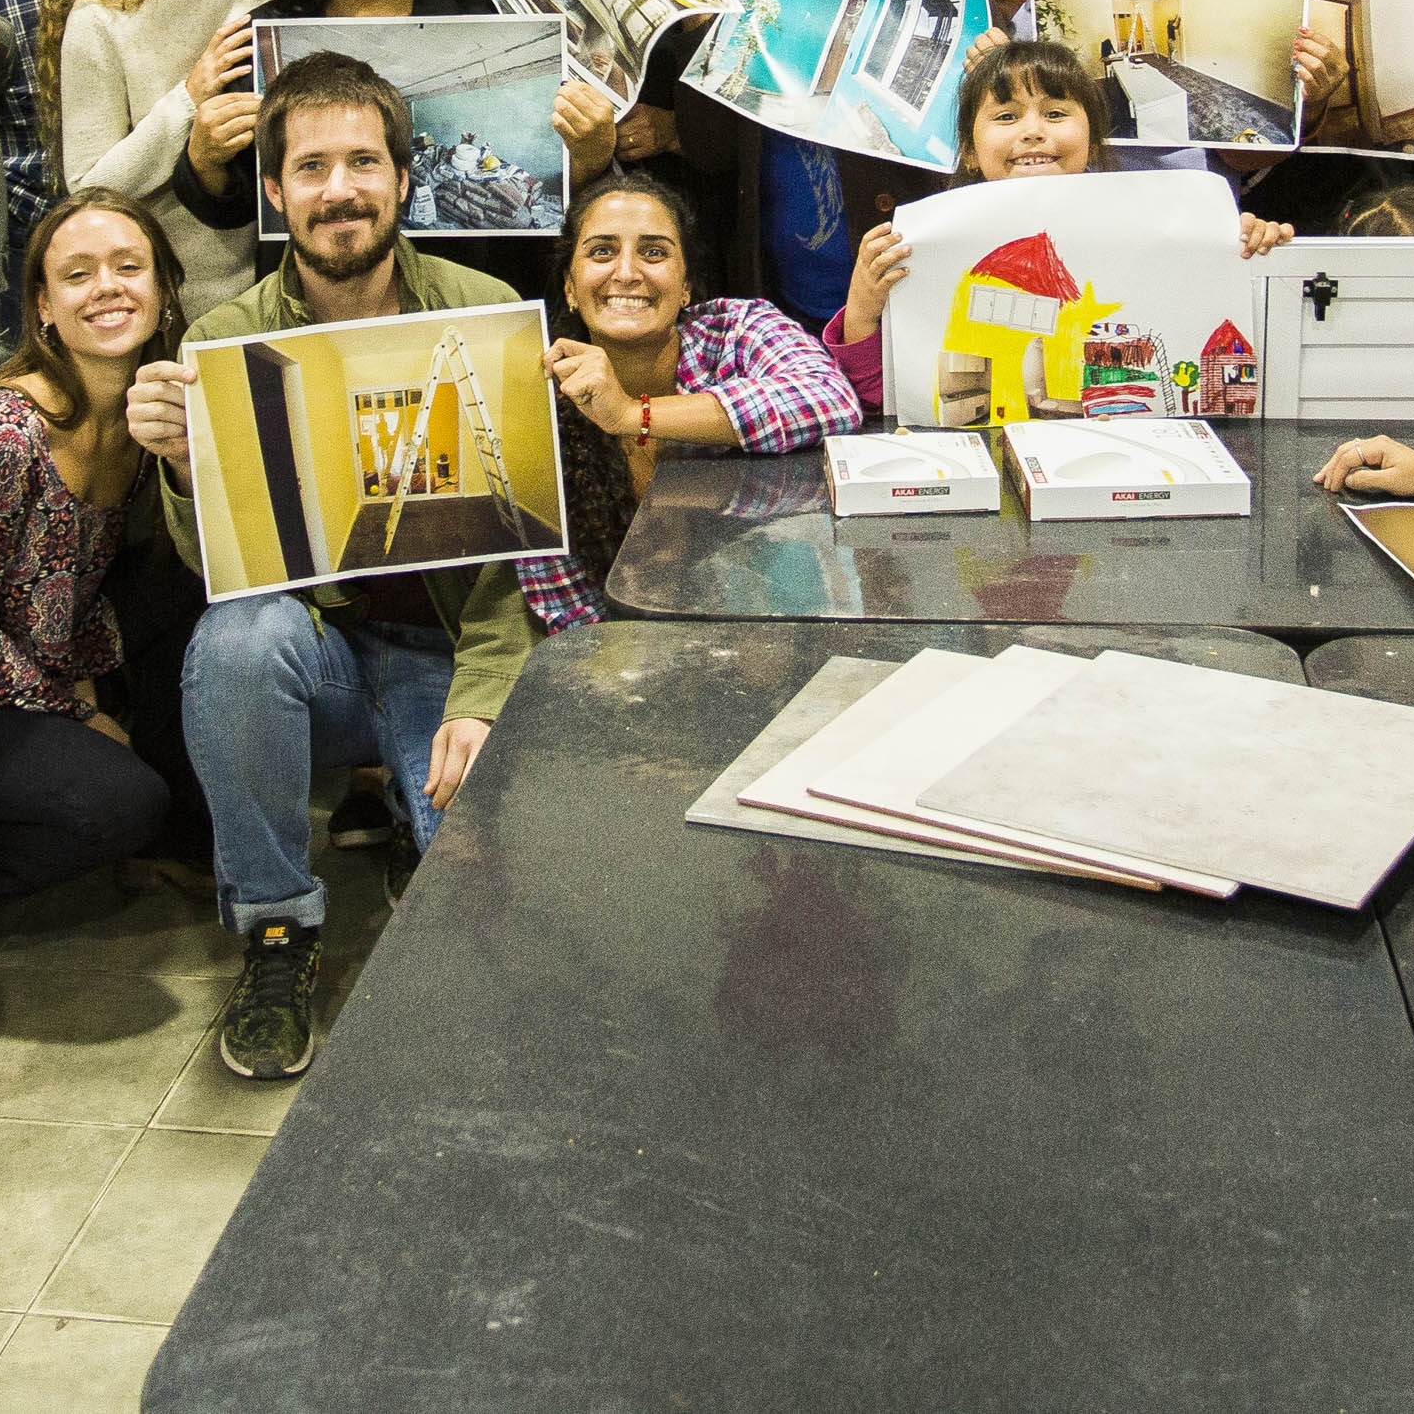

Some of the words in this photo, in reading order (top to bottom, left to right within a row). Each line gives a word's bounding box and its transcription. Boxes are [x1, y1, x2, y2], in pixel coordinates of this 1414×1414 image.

[893, 488, 915, 497] AKAI
[918, 487, 950, 496] ENERGY
[1113, 492, 1136, 501] AKAI
[1138, 491, 1170, 500] ENERGY
[265, 926, 286, 938] NIKE
